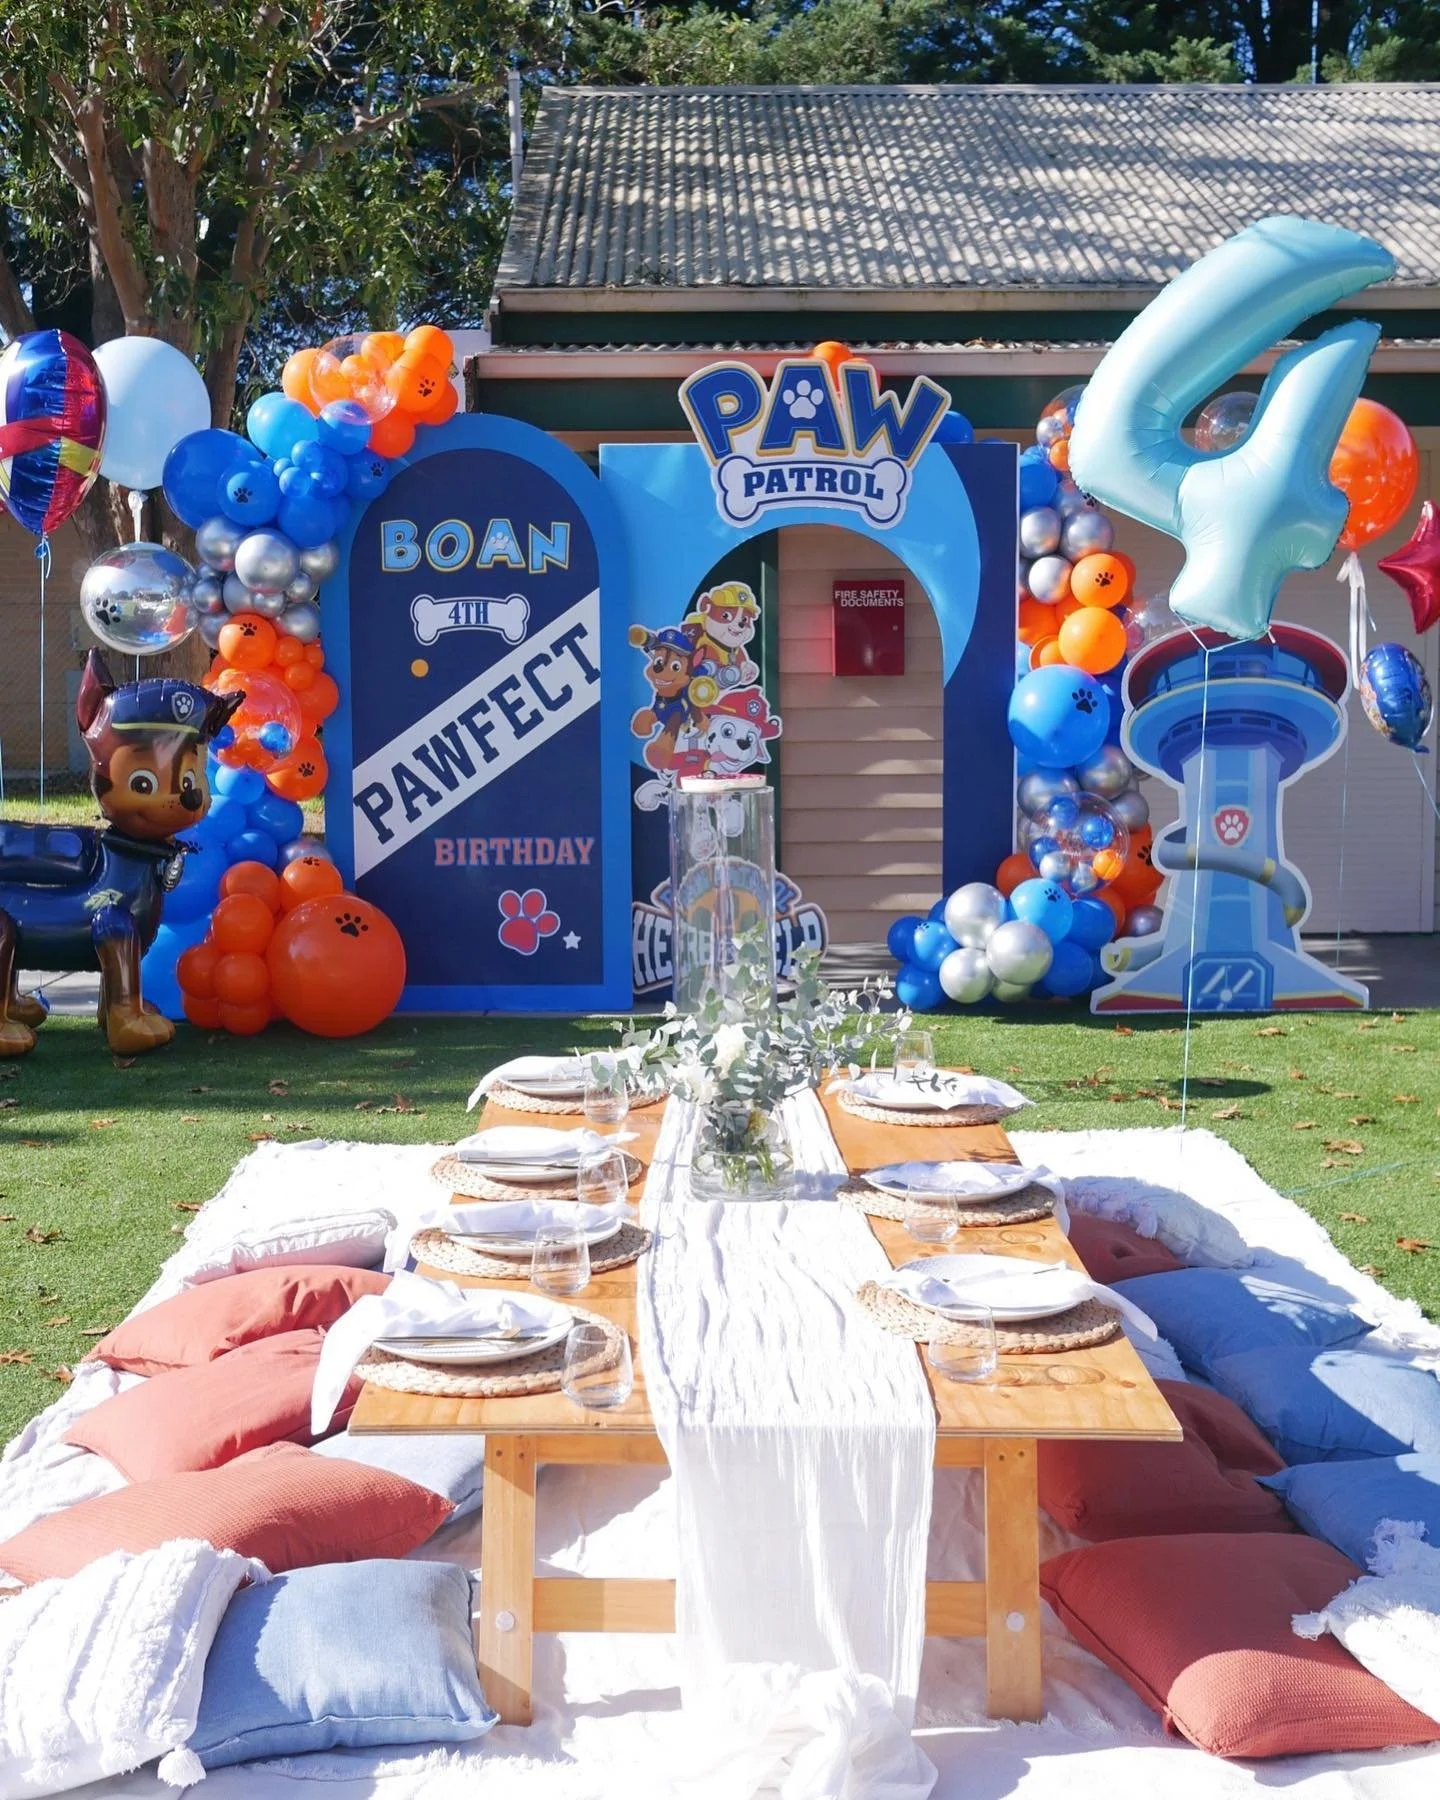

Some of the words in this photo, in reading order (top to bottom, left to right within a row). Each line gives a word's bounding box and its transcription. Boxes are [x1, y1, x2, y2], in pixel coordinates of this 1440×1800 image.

[684, 362, 948, 464] PAW
[1068, 215, 1397, 641] 4
[743, 467, 884, 500] PATROL
[380, 518, 571, 573] BOAN
[834, 590, 857, 600] FIRE
[860, 589, 899, 599] SAFETY
[841, 598, 904, 607] DOCUMENTS
[448, 601, 490, 626] 4TH
[353, 622, 601, 845] PAWFECT
[434, 837, 595, 866] BIRTHDAY
